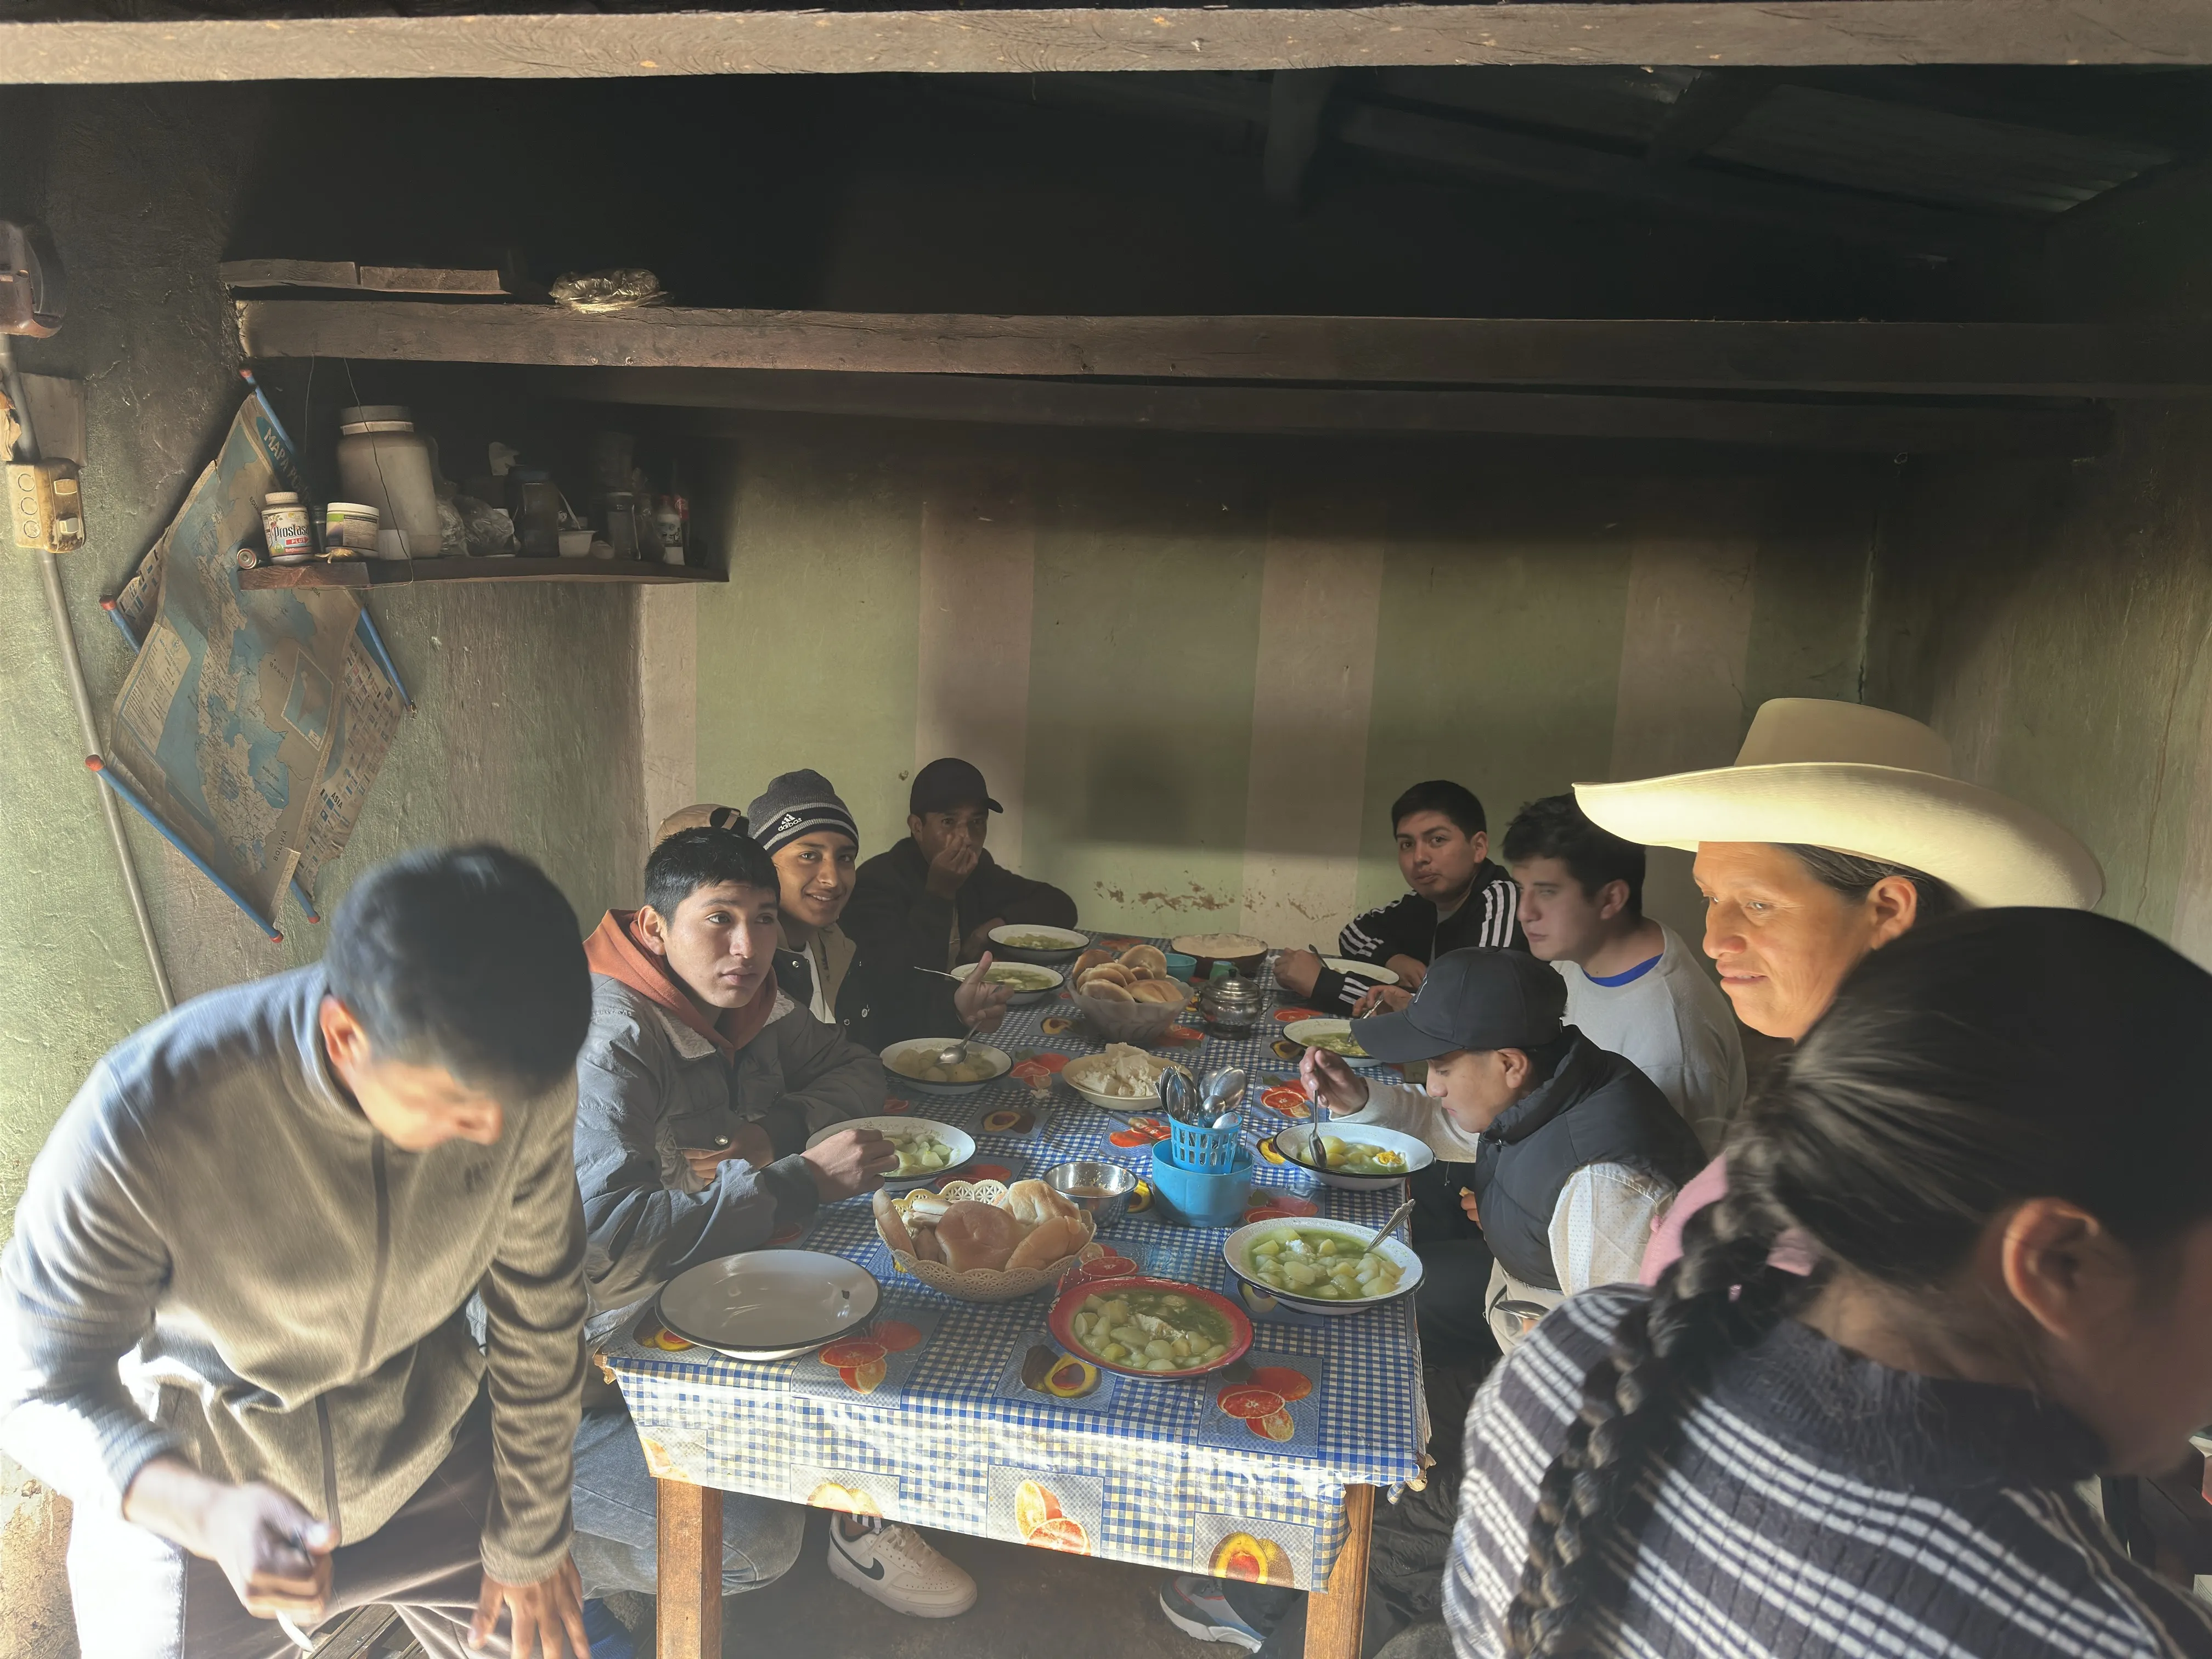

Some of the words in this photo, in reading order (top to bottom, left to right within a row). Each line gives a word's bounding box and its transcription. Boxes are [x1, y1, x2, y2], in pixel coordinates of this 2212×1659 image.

[264, 427, 289, 472] MAPA
[269, 661, 288, 683] BRASIL
[331, 792, 343, 809] ASIA
[273, 830, 288, 861] BOLIVIA
